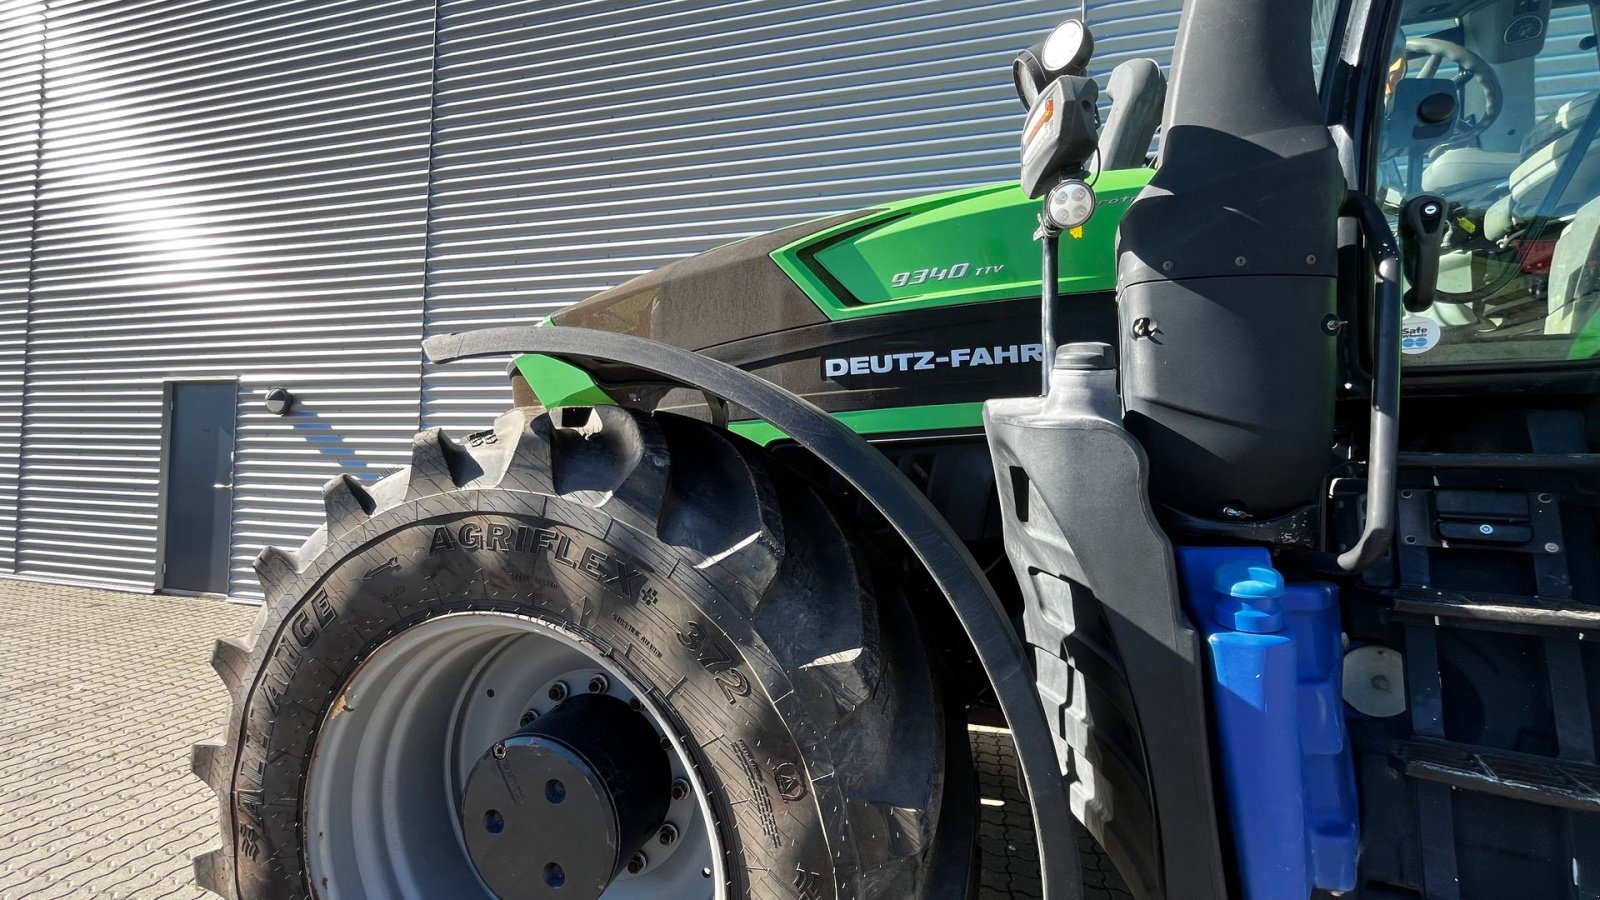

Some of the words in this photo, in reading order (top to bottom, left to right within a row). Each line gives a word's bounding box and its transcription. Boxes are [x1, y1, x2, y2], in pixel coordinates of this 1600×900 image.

[891, 262, 970, 288] 9340
[974, 264, 1004, 277] TTV
[825, 343, 1043, 377] DEUTZ-FAHR
[676, 620, 751, 705] 372
[236, 587, 337, 829] ALLIANCE
